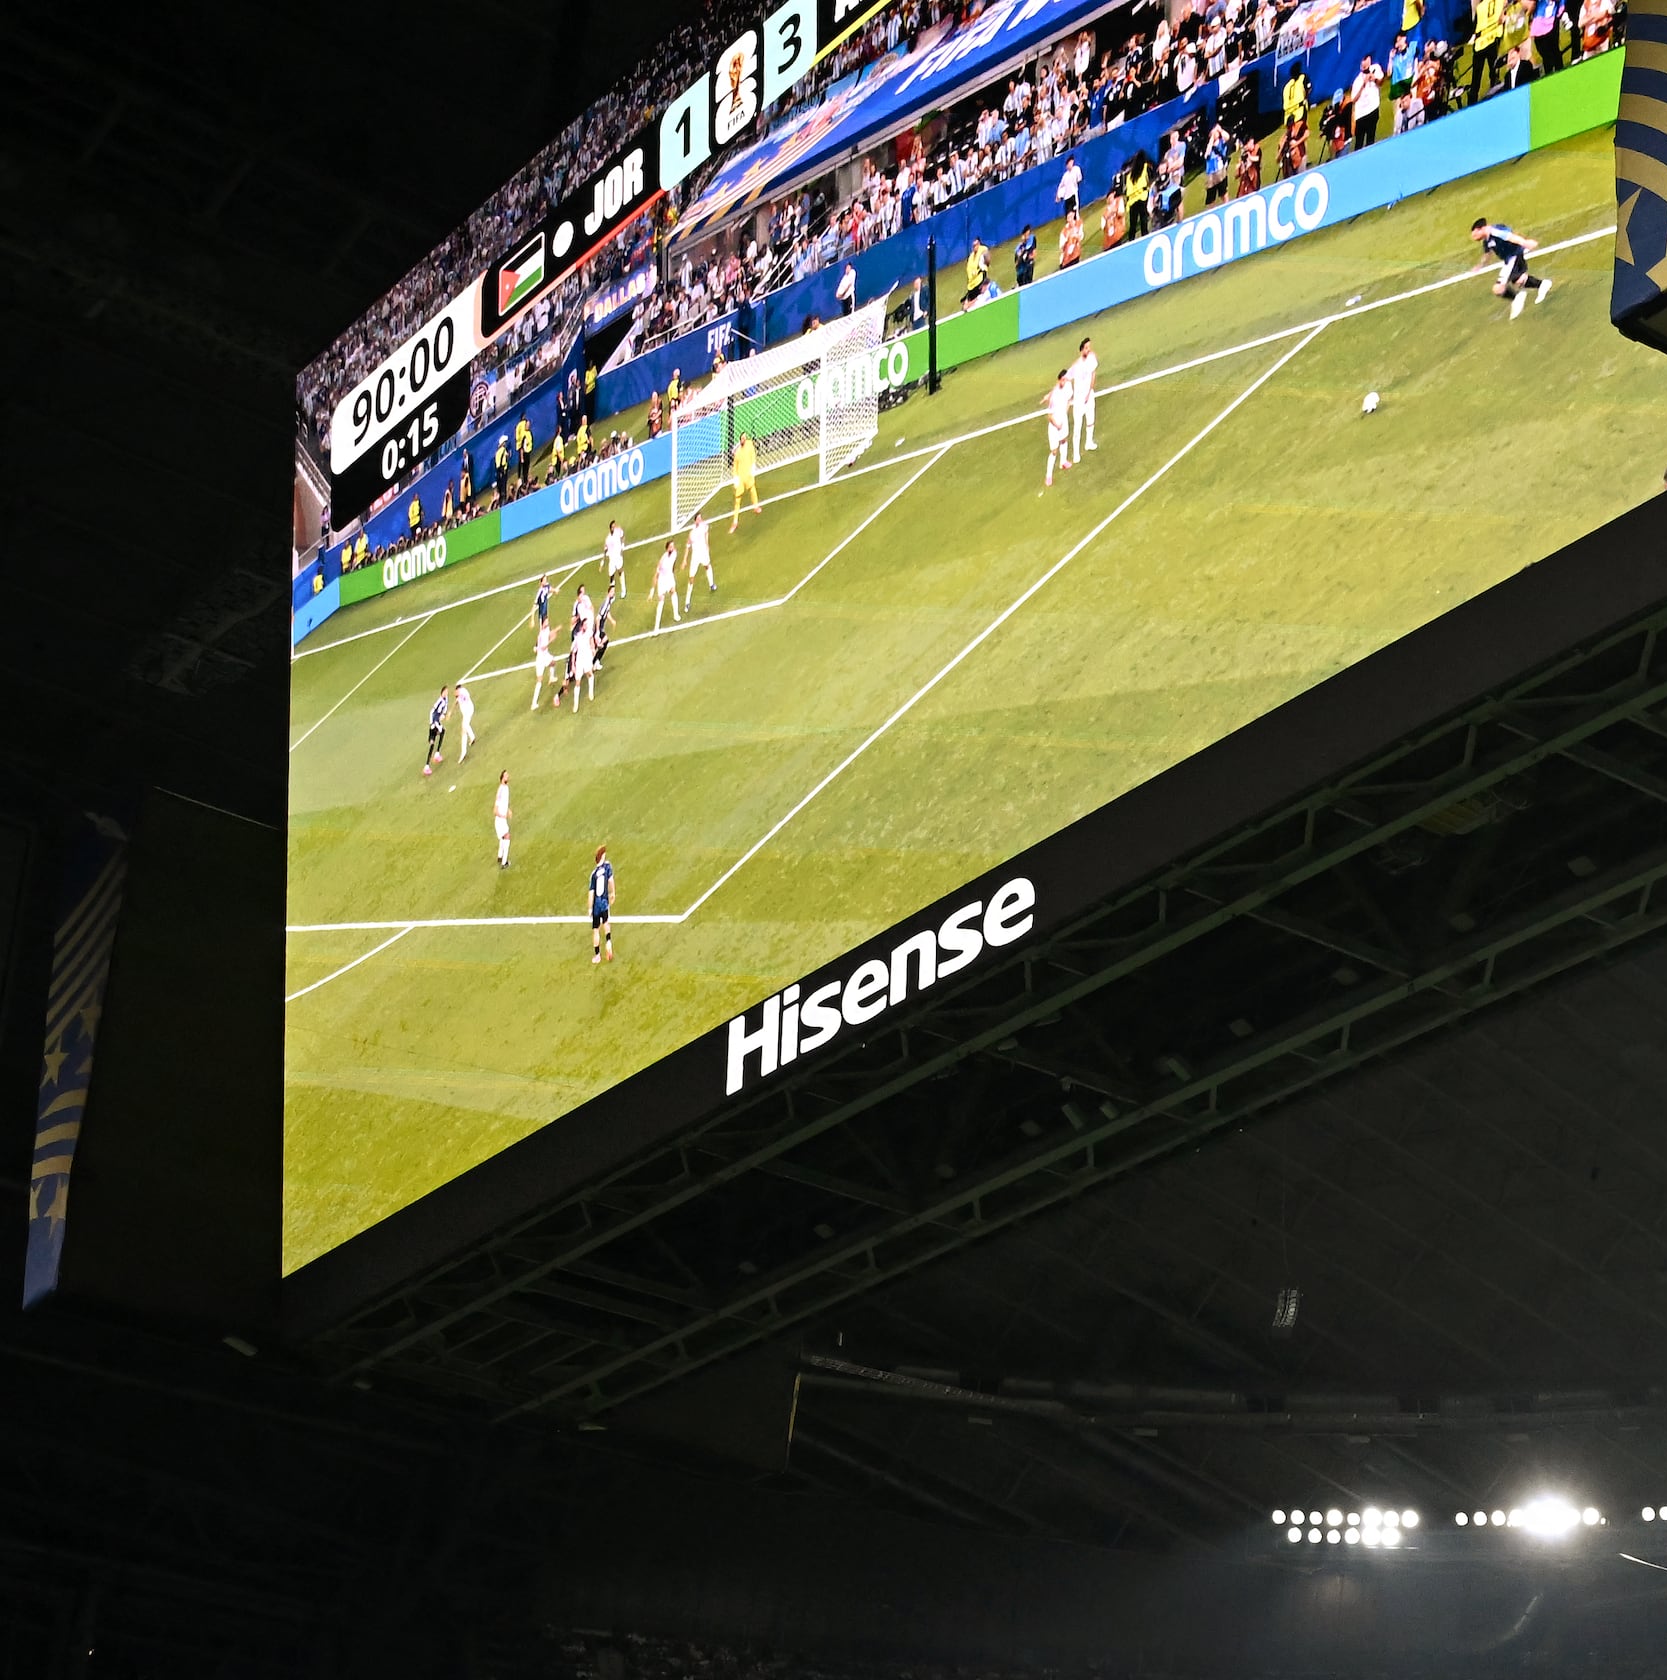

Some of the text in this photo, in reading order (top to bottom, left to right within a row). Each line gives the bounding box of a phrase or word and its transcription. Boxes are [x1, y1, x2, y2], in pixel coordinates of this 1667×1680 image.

[777, 13, 801, 77] 3
[675, 102, 694, 160] 1
[726, 113, 749, 132] FIFA
[584, 146, 644, 236] JOR
[1143, 172, 1330, 287] aramco
[593, 273, 646, 324] DALLAS
[352, 315, 454, 446] 90:00
[797, 337, 909, 421] aramco
[381, 403, 439, 481] 0:15
[560, 448, 645, 516] aramco
[383, 537, 447, 588] aramco
[726, 877, 1036, 1097] Hisense
